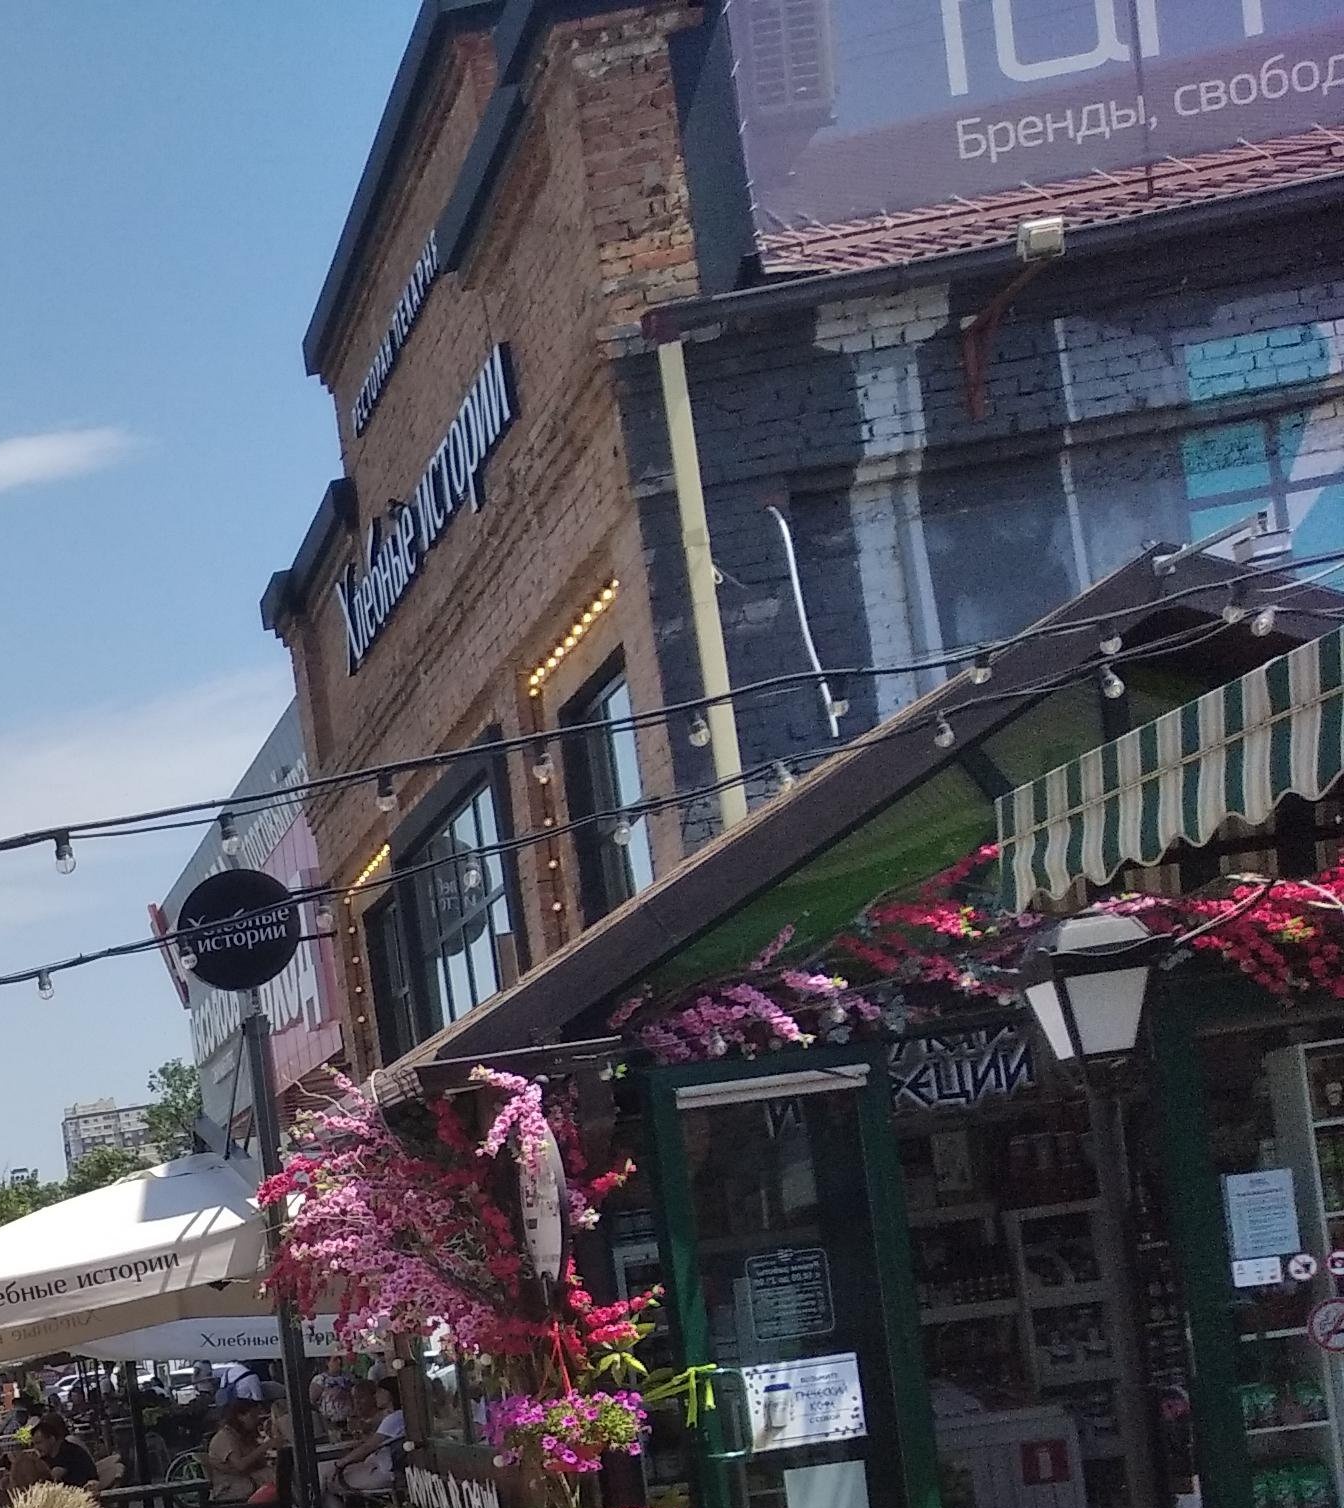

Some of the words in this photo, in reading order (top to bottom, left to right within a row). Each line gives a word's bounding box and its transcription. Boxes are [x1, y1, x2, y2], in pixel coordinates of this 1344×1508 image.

[956, 94, 1159, 164] Бренды,
[352, 331, 394, 438] РЕСТОРАН
[336, 504, 416, 677] Хлебные
[415, 342, 511, 551] истории
[197, 923, 287, 954] истории
[77, 1251, 180, 1289] истории
[200, 1331, 279, 1349] Хлебные
